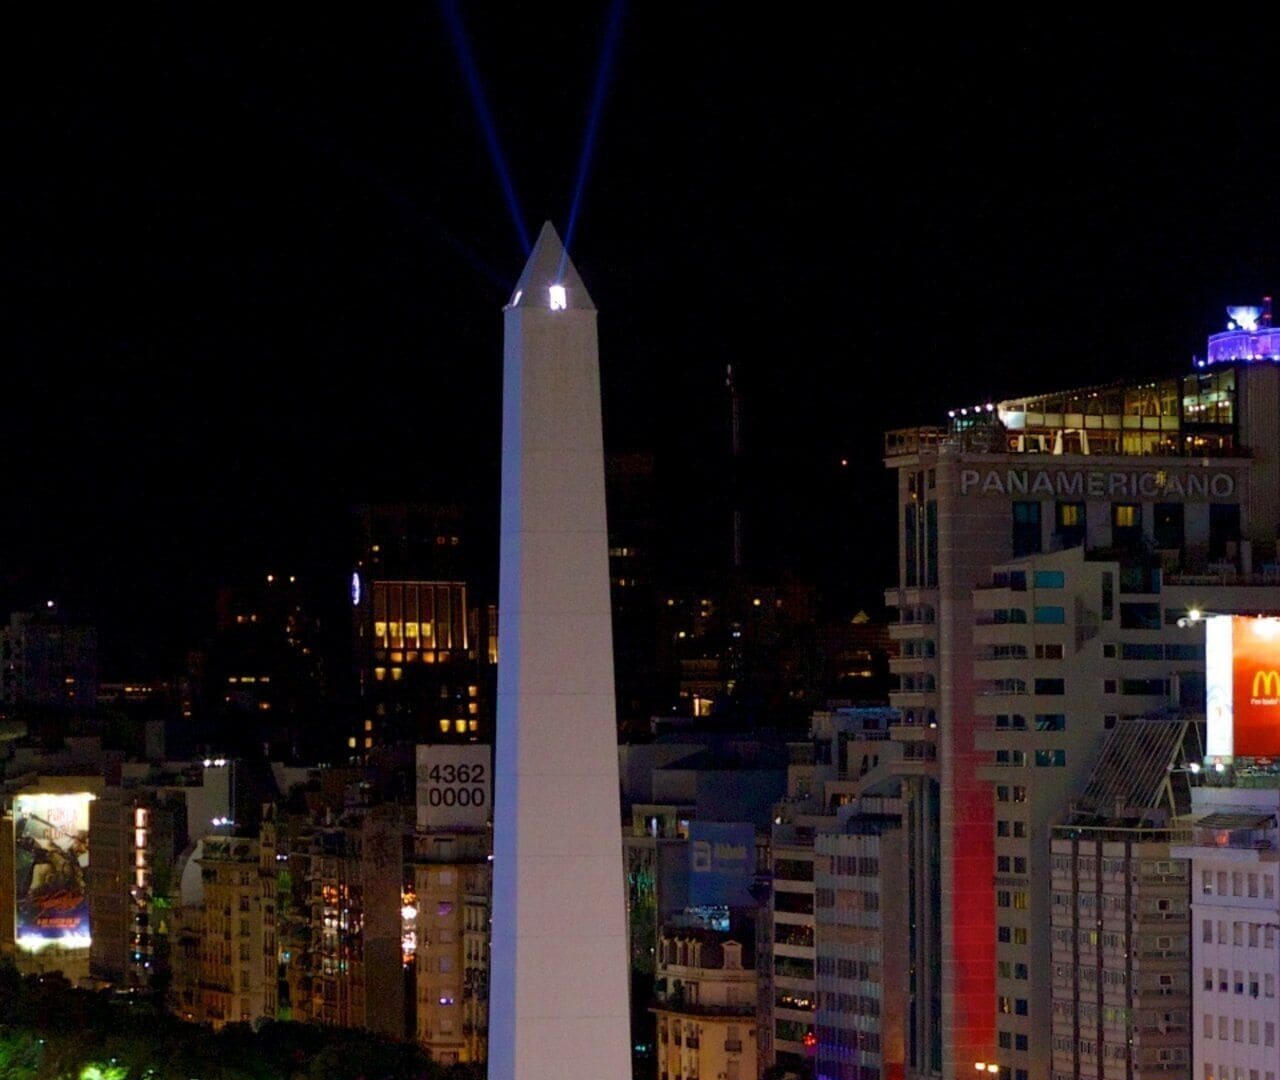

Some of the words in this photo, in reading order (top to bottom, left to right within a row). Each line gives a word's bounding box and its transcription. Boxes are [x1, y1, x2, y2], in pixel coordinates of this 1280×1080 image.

[960, 469, 1235, 498] PANAMERICANO
[429, 764, 485, 783] 4362
[429, 788, 485, 807] 0000
